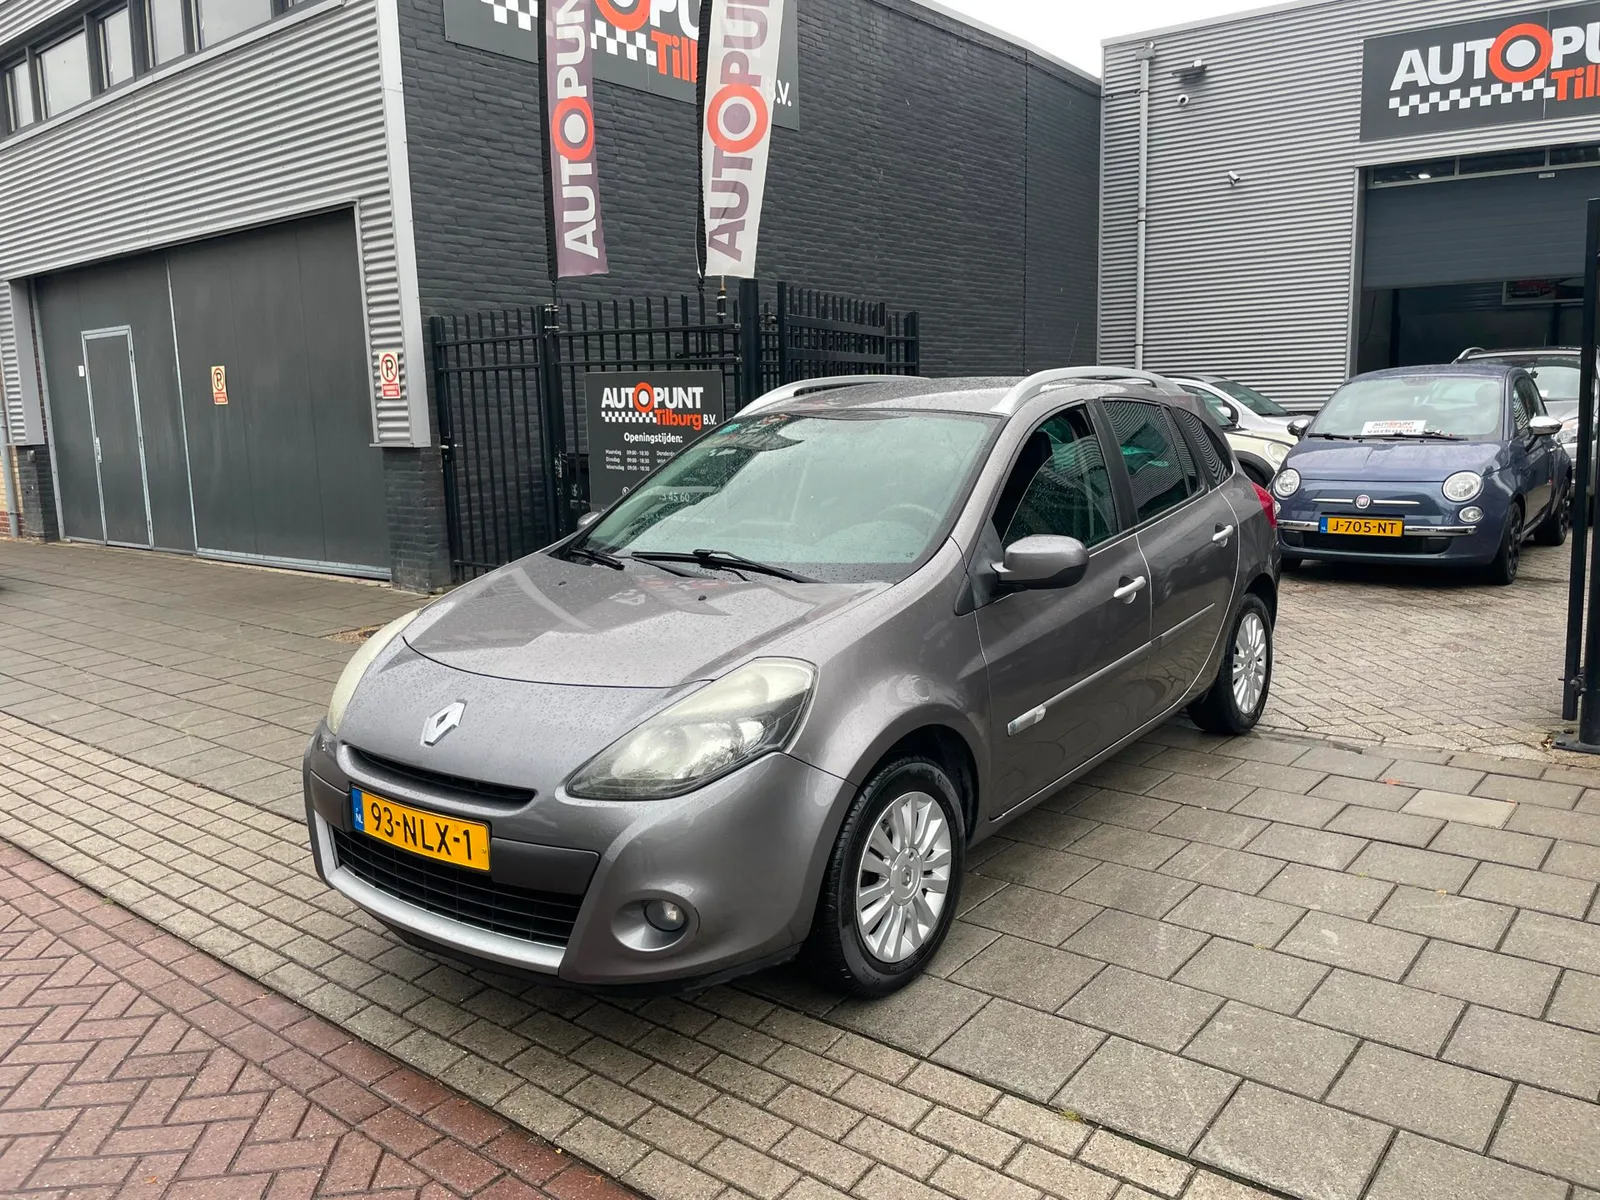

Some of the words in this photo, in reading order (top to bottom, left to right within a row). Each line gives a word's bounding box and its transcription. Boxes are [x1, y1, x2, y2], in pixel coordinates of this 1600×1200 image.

[707, 0, 770, 262] AUTOPU
[601, 382, 704, 414] AUTOPUNT
[654, 408, 702, 430] Tilburg
[703, 414, 717, 425] B.V.
[624, 432, 683, 444] Openingstijden:
[1332, 520, 1397, 534] J-705-NT
[371, 802, 472, 861] 93-NLX-1
